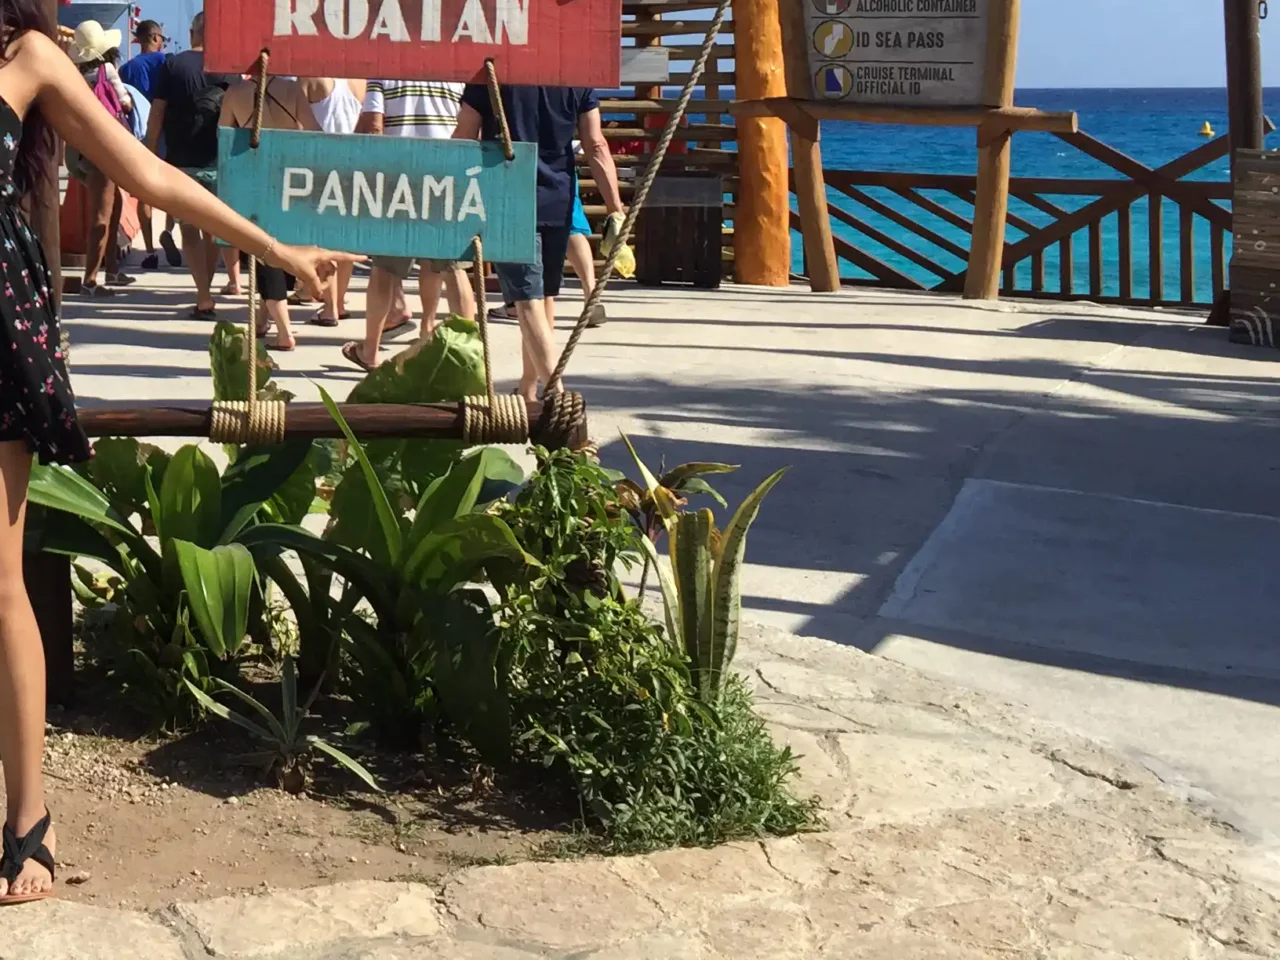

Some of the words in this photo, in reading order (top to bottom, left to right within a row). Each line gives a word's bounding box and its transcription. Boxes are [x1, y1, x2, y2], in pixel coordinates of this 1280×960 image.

[856, 32, 870, 48] ID
[875, 32, 902, 48] SEA
[907, 32, 944, 48] PASS
[856, 66, 894, 81] CRUISE
[898, 67, 955, 82] TERMINAL
[856, 81, 906, 94] OFFICIAL
[909, 82, 921, 95] ID
[281, 166, 487, 223] PANAMÁ
